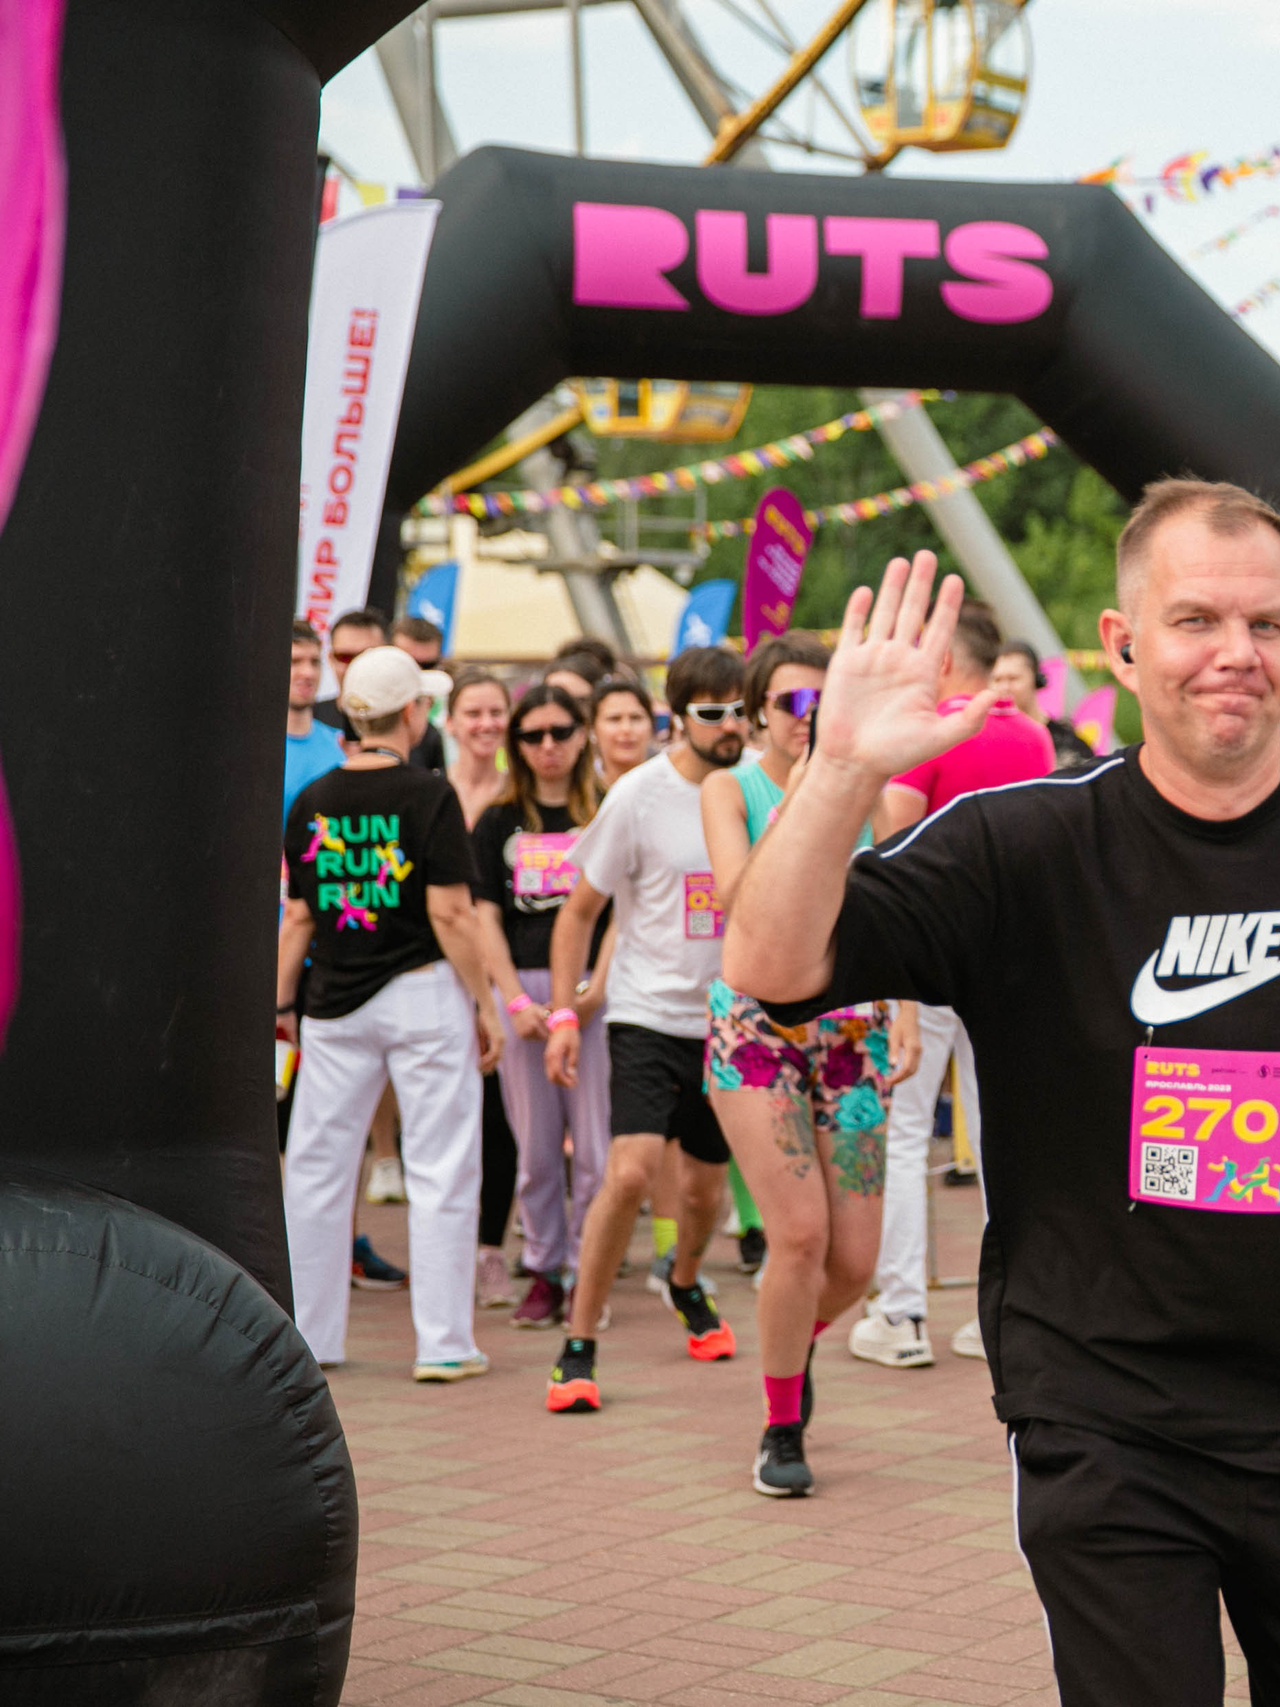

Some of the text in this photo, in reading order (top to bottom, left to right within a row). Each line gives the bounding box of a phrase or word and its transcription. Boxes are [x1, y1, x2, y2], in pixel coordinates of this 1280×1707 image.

[573, 201, 1053, 324] RUTS
[322, 308, 379, 529] БОЛЬШЕ!
[318, 880, 400, 911] RUN
[1145, 1060, 1201, 1078] RUTS
[1145, 1080, 1207, 1092] ЯРОСЛАВЛЬ
[1140, 1095, 1279, 1144] 270
